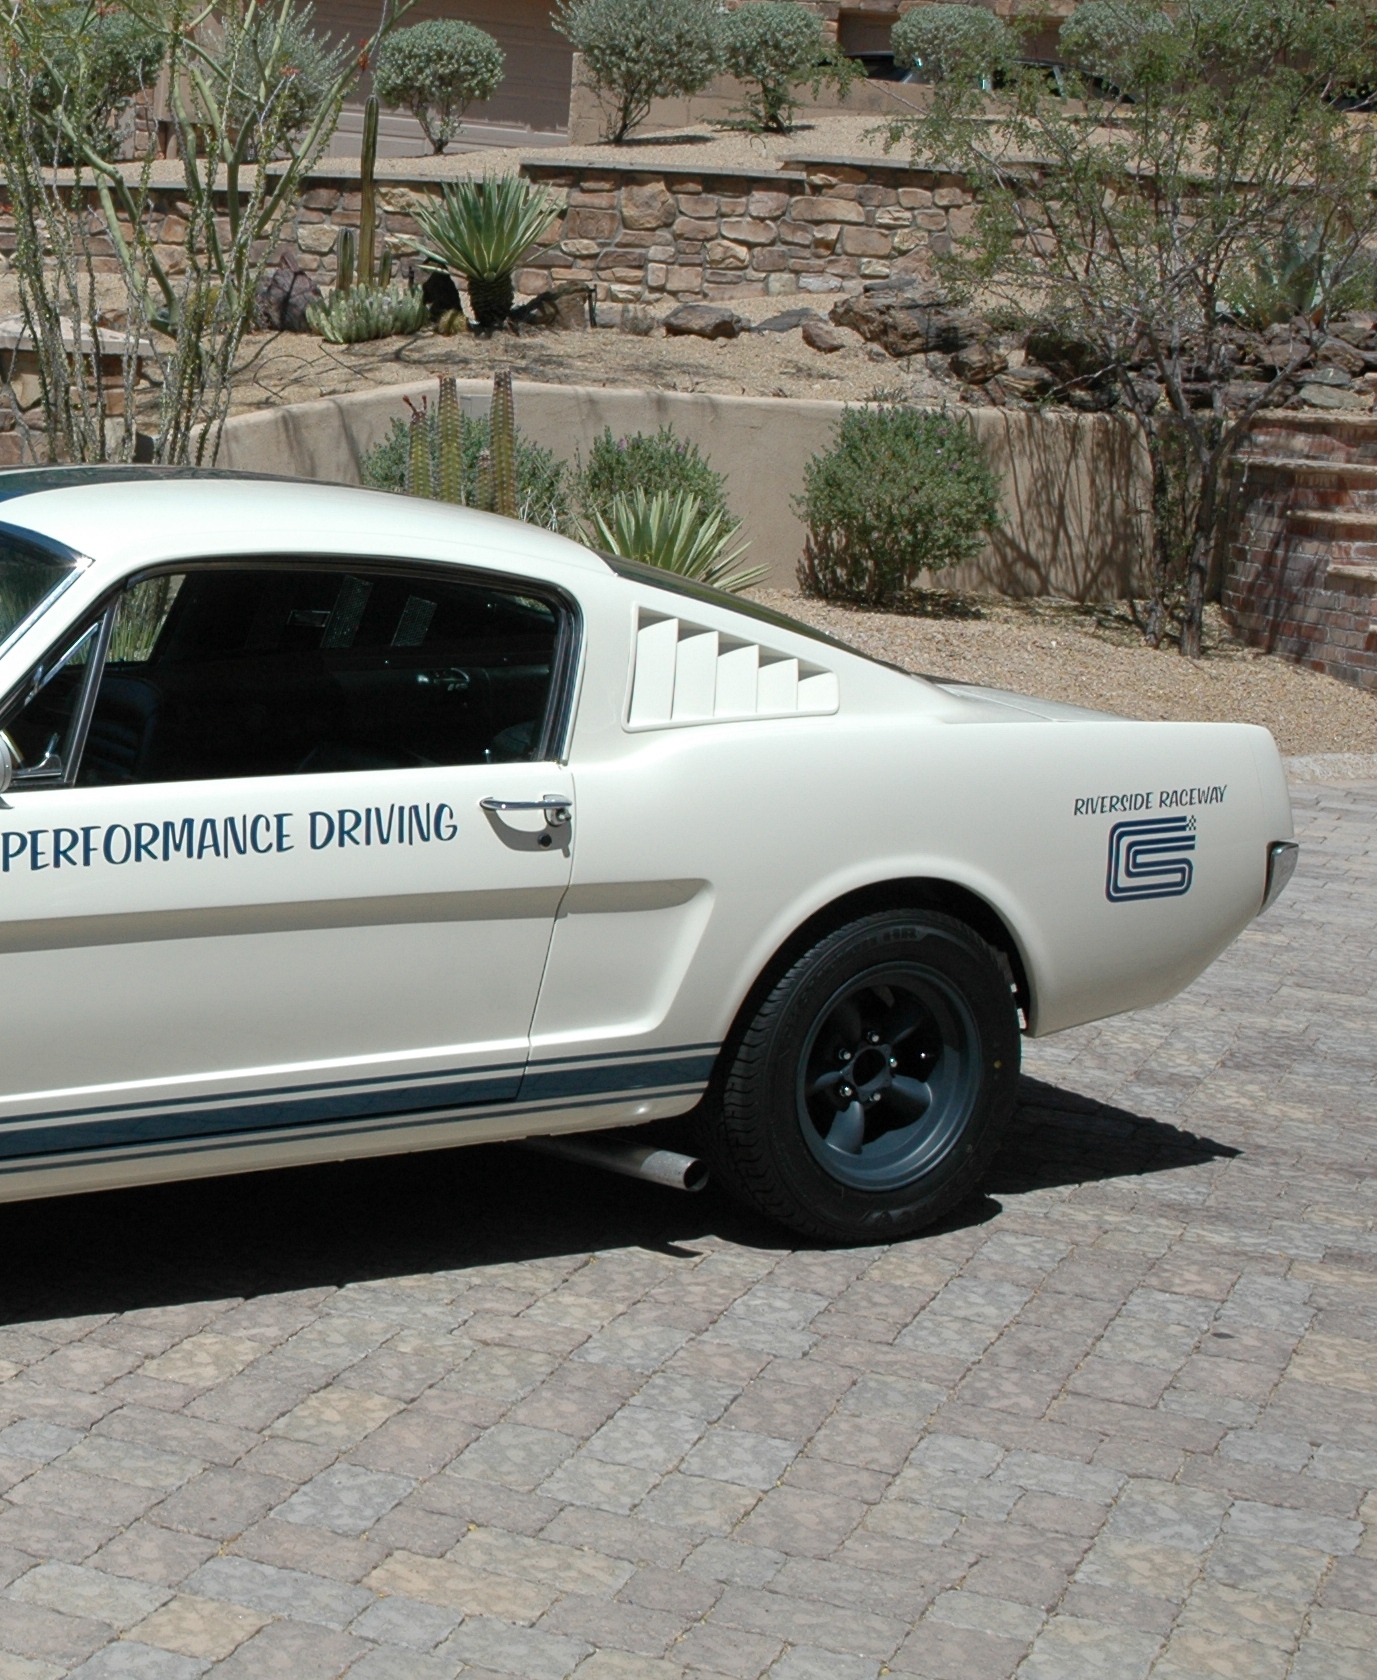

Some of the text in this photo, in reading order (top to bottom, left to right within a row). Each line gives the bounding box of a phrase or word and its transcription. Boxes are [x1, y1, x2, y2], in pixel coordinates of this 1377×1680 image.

[1073, 784, 1228, 817] RIVERSIDE RACEWAY
[1, 812, 295, 873] PERFORMANCE
[308, 802, 459, 851] DRIVING
